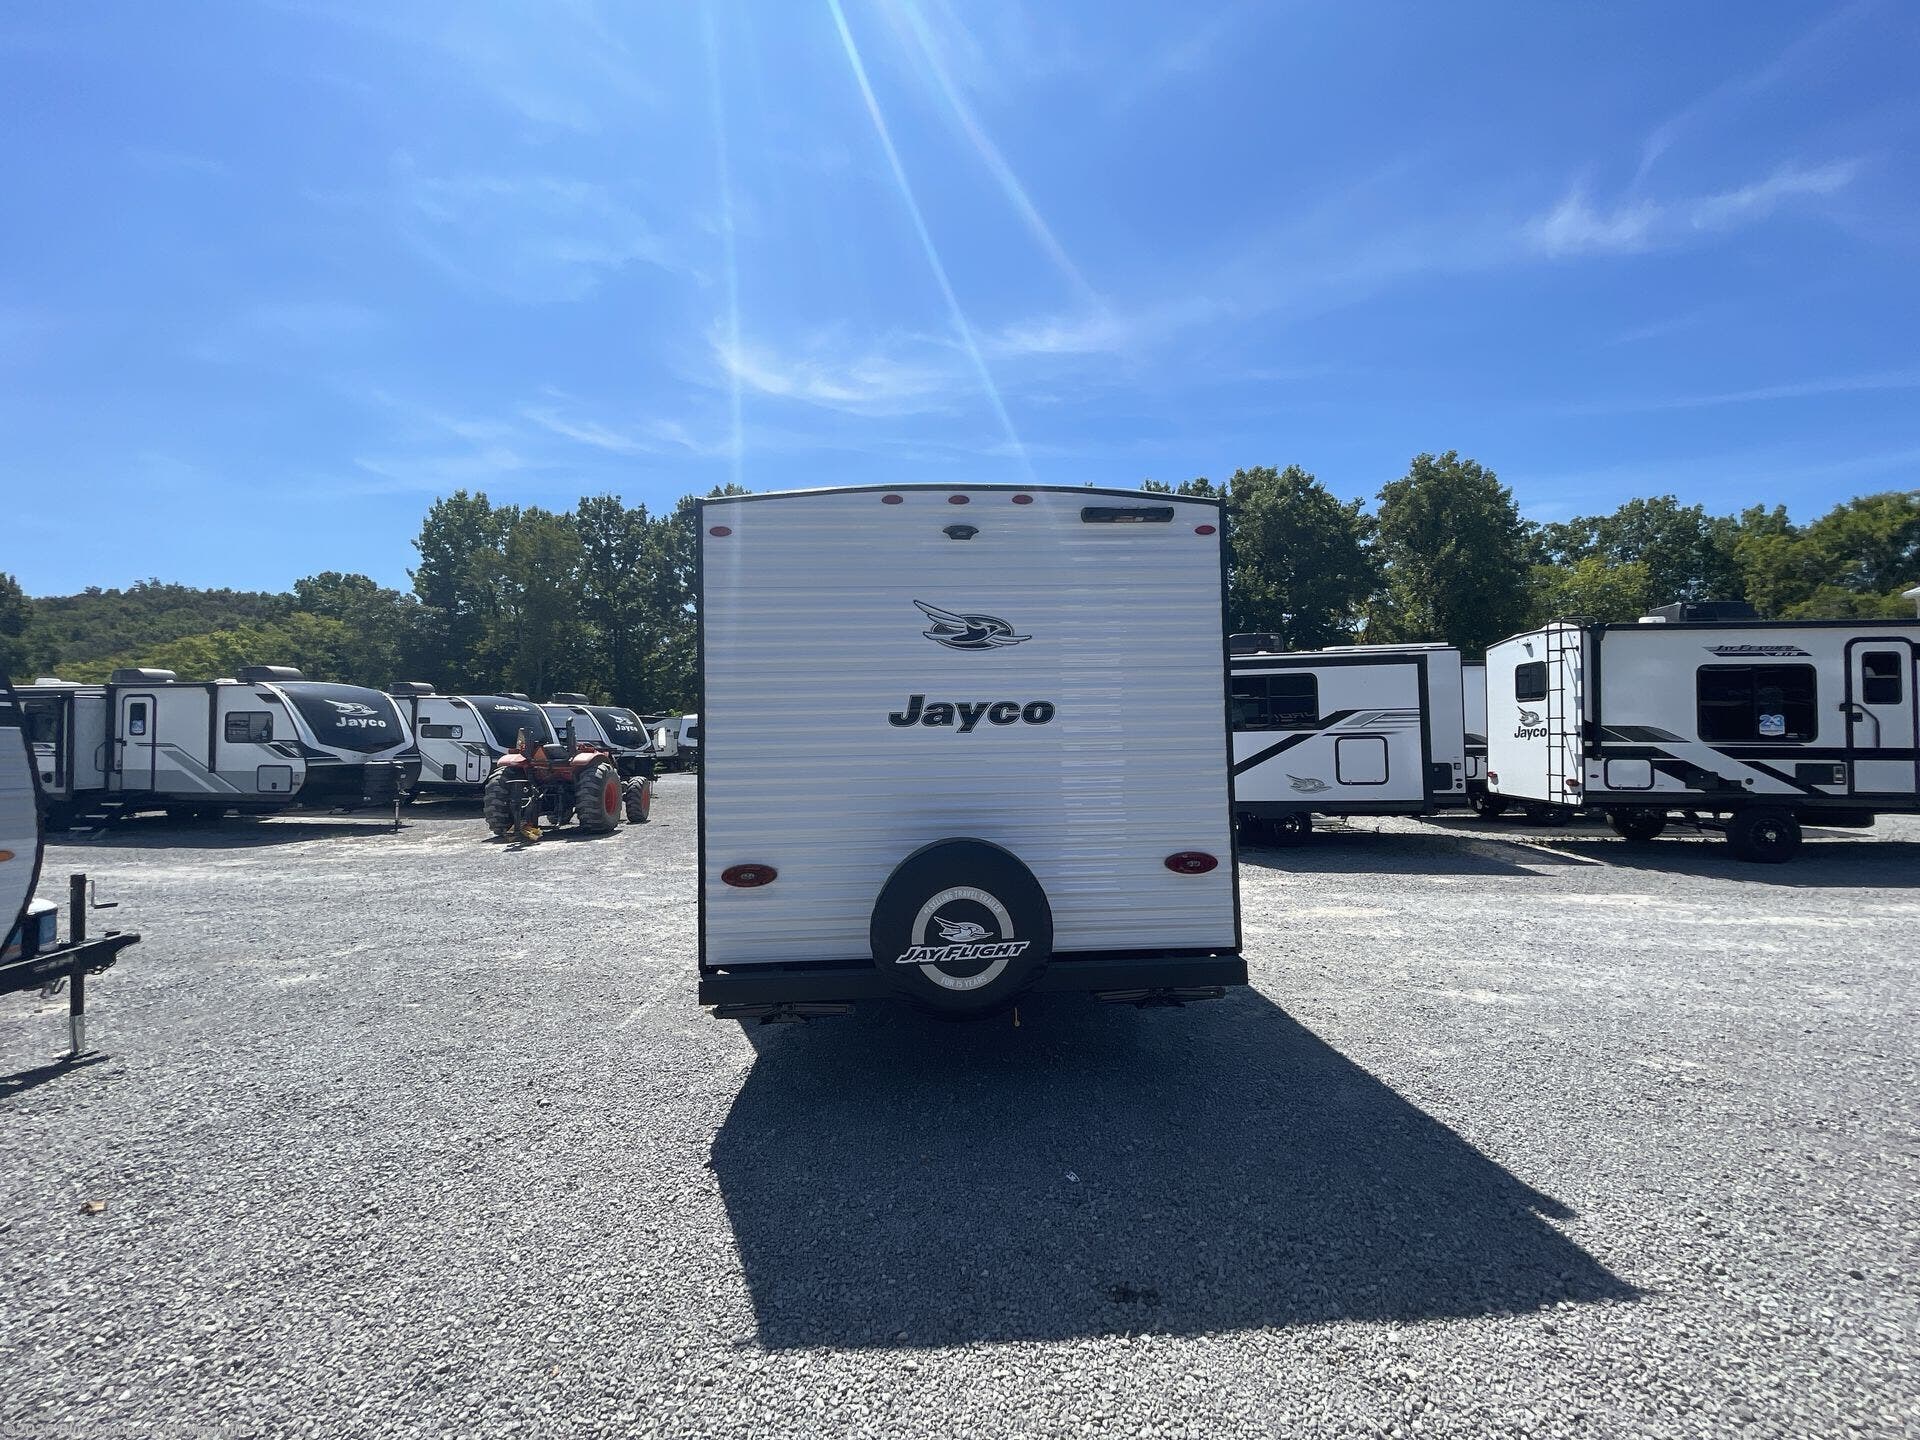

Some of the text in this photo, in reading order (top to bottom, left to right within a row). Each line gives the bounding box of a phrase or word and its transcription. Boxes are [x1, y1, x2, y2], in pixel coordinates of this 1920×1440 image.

[888, 694, 1055, 734] Jayco
[336, 717, 387, 728] Jayco
[615, 724, 638, 732] Jayco
[1514, 726, 1547, 741] Jayco
[954, 890, 977, 900] TRAVEL
[941, 977, 954, 987] FOR
[964, 976, 987, 987] YEARS
